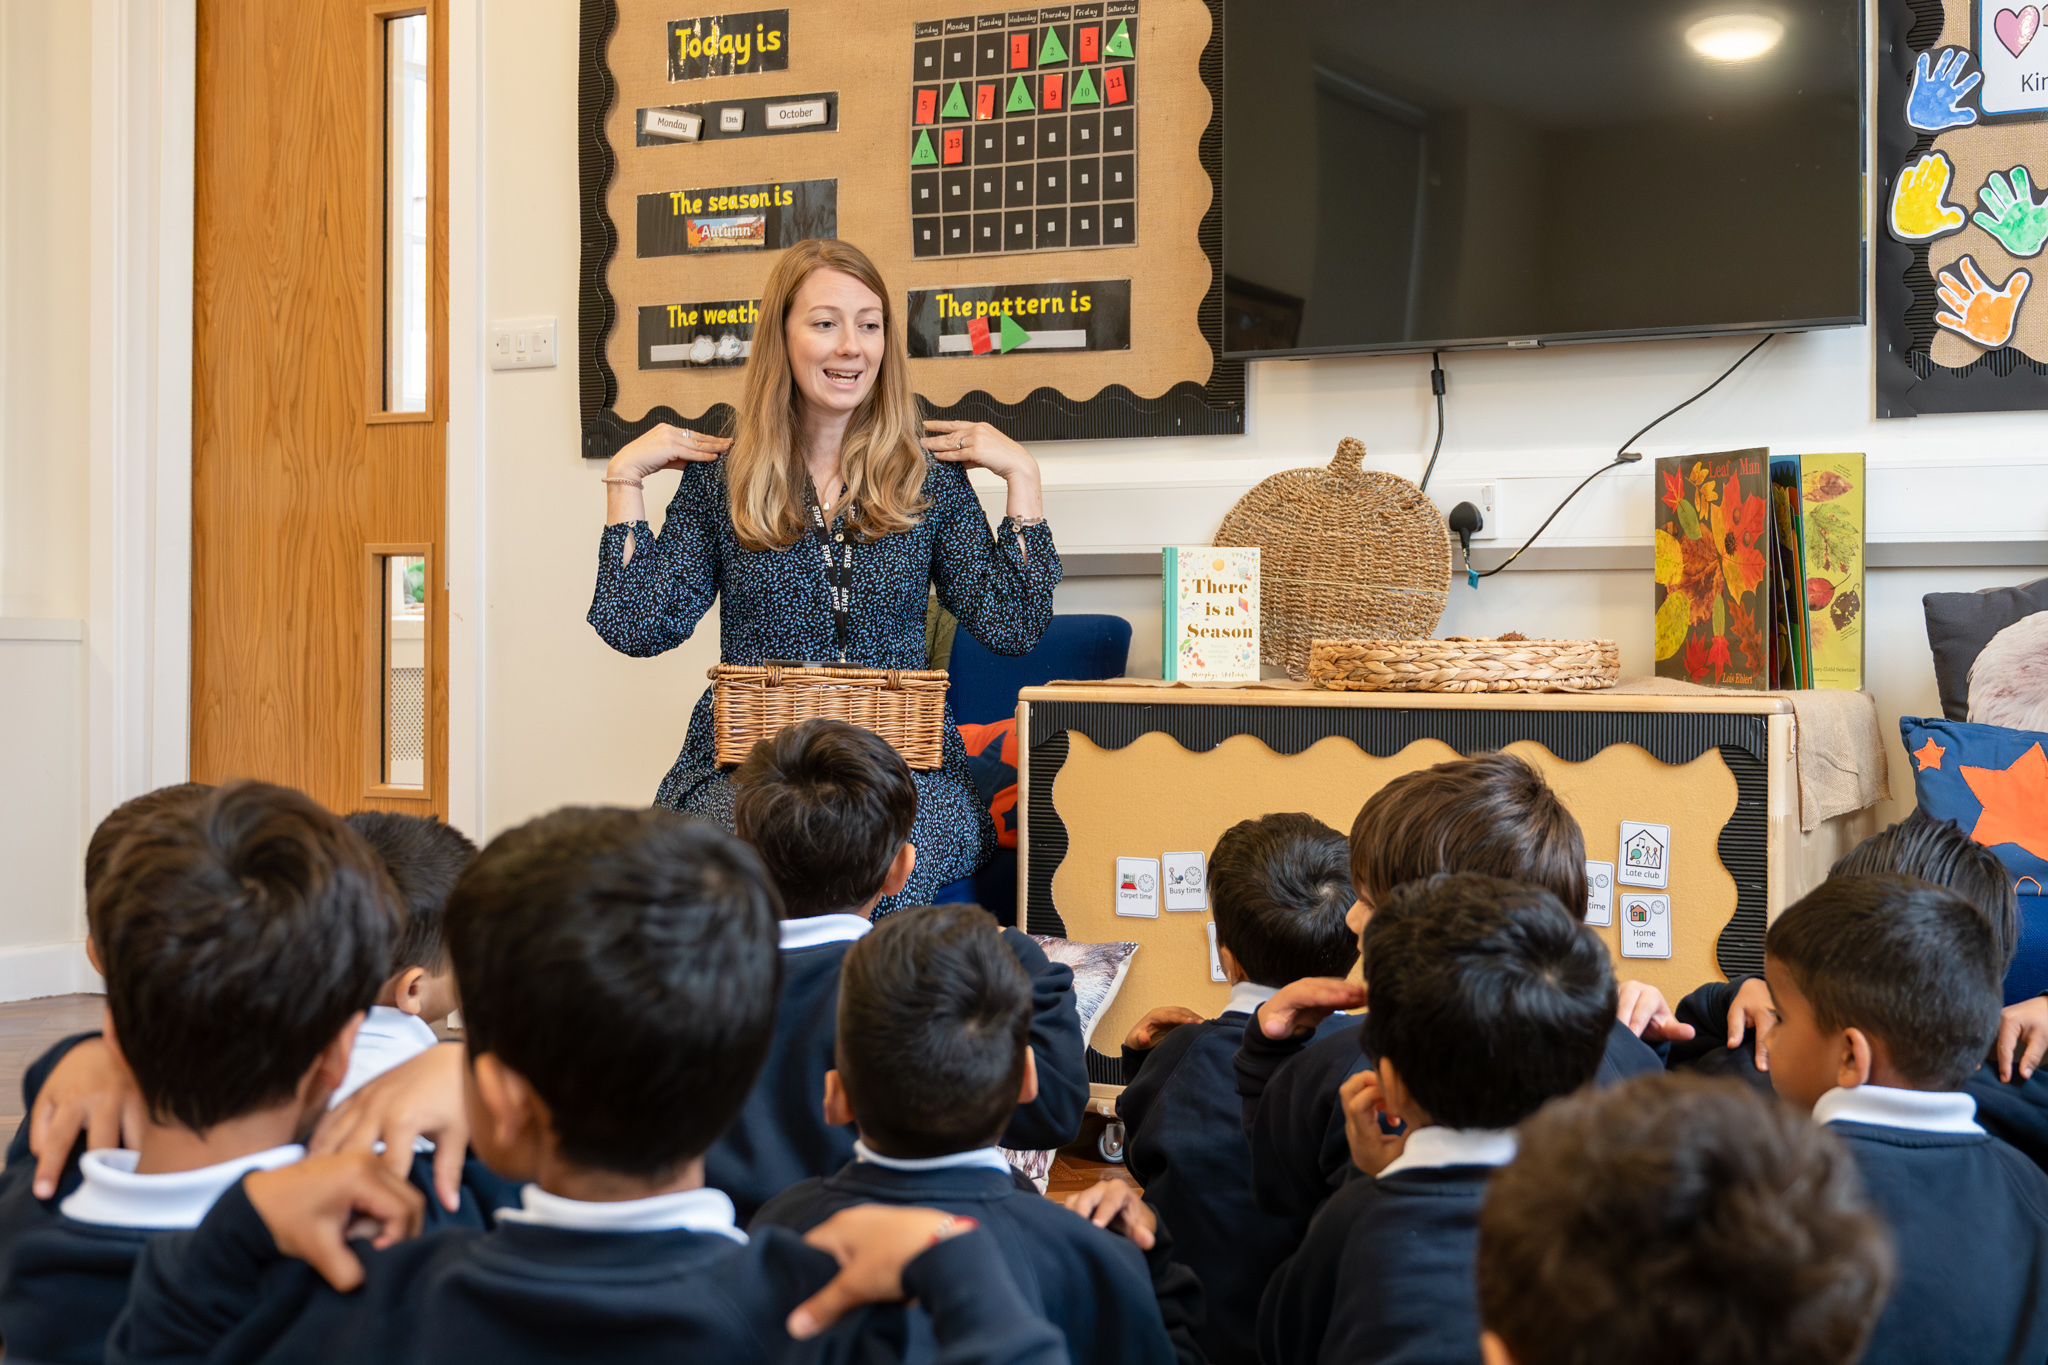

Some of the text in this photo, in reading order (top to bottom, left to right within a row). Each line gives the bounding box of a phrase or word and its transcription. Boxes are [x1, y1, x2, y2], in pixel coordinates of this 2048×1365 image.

[1075, 8, 1098, 17] Friday
[1107, 4, 1136, 13] Saturday
[1008, 14, 1037, 24] Wednesday
[1041, 10, 1070, 19] Thursday
[946, 22, 970, 31] Monday
[979, 18, 1002, 28] Tuesday
[916, 26, 939, 36] Sunday
[675, 23, 781, 65] Today is
[1085, 37, 1091, 47] 3
[1116, 41, 1122, 50] 4
[1014, 44, 1020, 54] 1
[1049, 47, 1055, 56] 2
[1109, 77, 1122, 88] 11
[1050, 91, 1057, 101] 9
[1080, 88, 1090, 97] 10
[981, 94, 987, 104] 7
[1017, 95, 1023, 104] 8
[921, 101, 928, 110] 5
[953, 102, 959, 111] 6
[779, 107, 813, 119] October
[657, 117, 688, 133] Monday
[725, 116, 738, 124] 13th
[948, 138, 960, 149] 13
[920, 149, 929, 158] 12
[669, 186, 793, 215] The season is
[700, 224, 751, 239] Autumn
[935, 290, 1092, 319] The pattern is
[666, 300, 759, 328] The weath
[1708, 457, 1760, 478] Leaf Man
[812, 505, 825, 528] STAFF
[822, 544, 833, 568] STAFF
[843, 544, 853, 569] STAFF
[1192, 579, 1248, 594] There
[830, 586, 841, 611] STAFF
[841, 587, 849, 612] STAFF
[1205, 602, 1235, 616] is a
[1187, 623, 1253, 638] Season
[1722, 672, 1753, 684] Lois Ehlert
[1625, 869, 1660, 879] Late club
[1120, 891, 1138, 900] Carpet
[1169, 887, 1184, 895] Busy
[1588, 902, 1606, 910] time
[1633, 929, 1656, 937] Home
